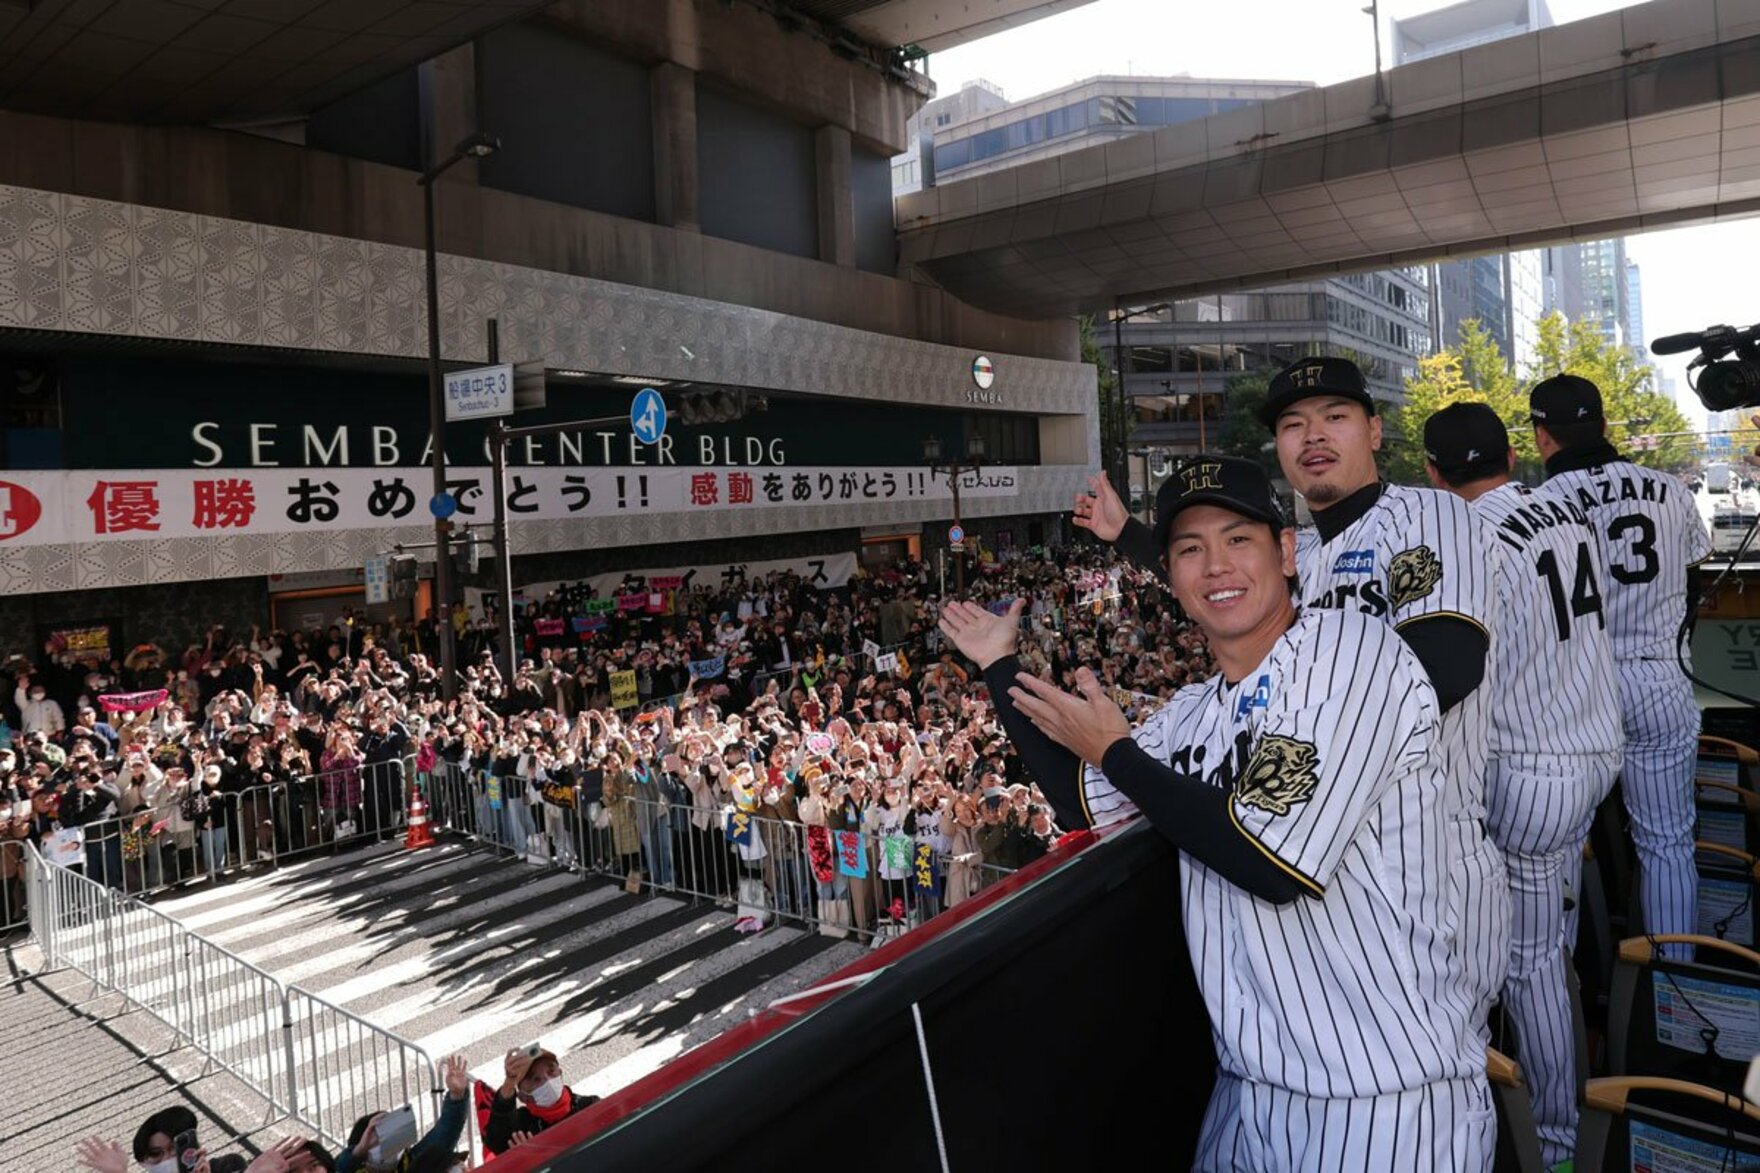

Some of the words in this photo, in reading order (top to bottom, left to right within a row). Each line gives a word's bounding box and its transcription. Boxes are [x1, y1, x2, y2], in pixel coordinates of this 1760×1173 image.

[966, 390, 1003, 404] SEMBA
[192, 422, 450, 467] SEMBA
[700, 435, 786, 466] BLDG
[1577, 477, 1667, 512] AZAKI
[1497, 493, 1599, 554] IWASAD
[1536, 541, 1605, 642] 14
